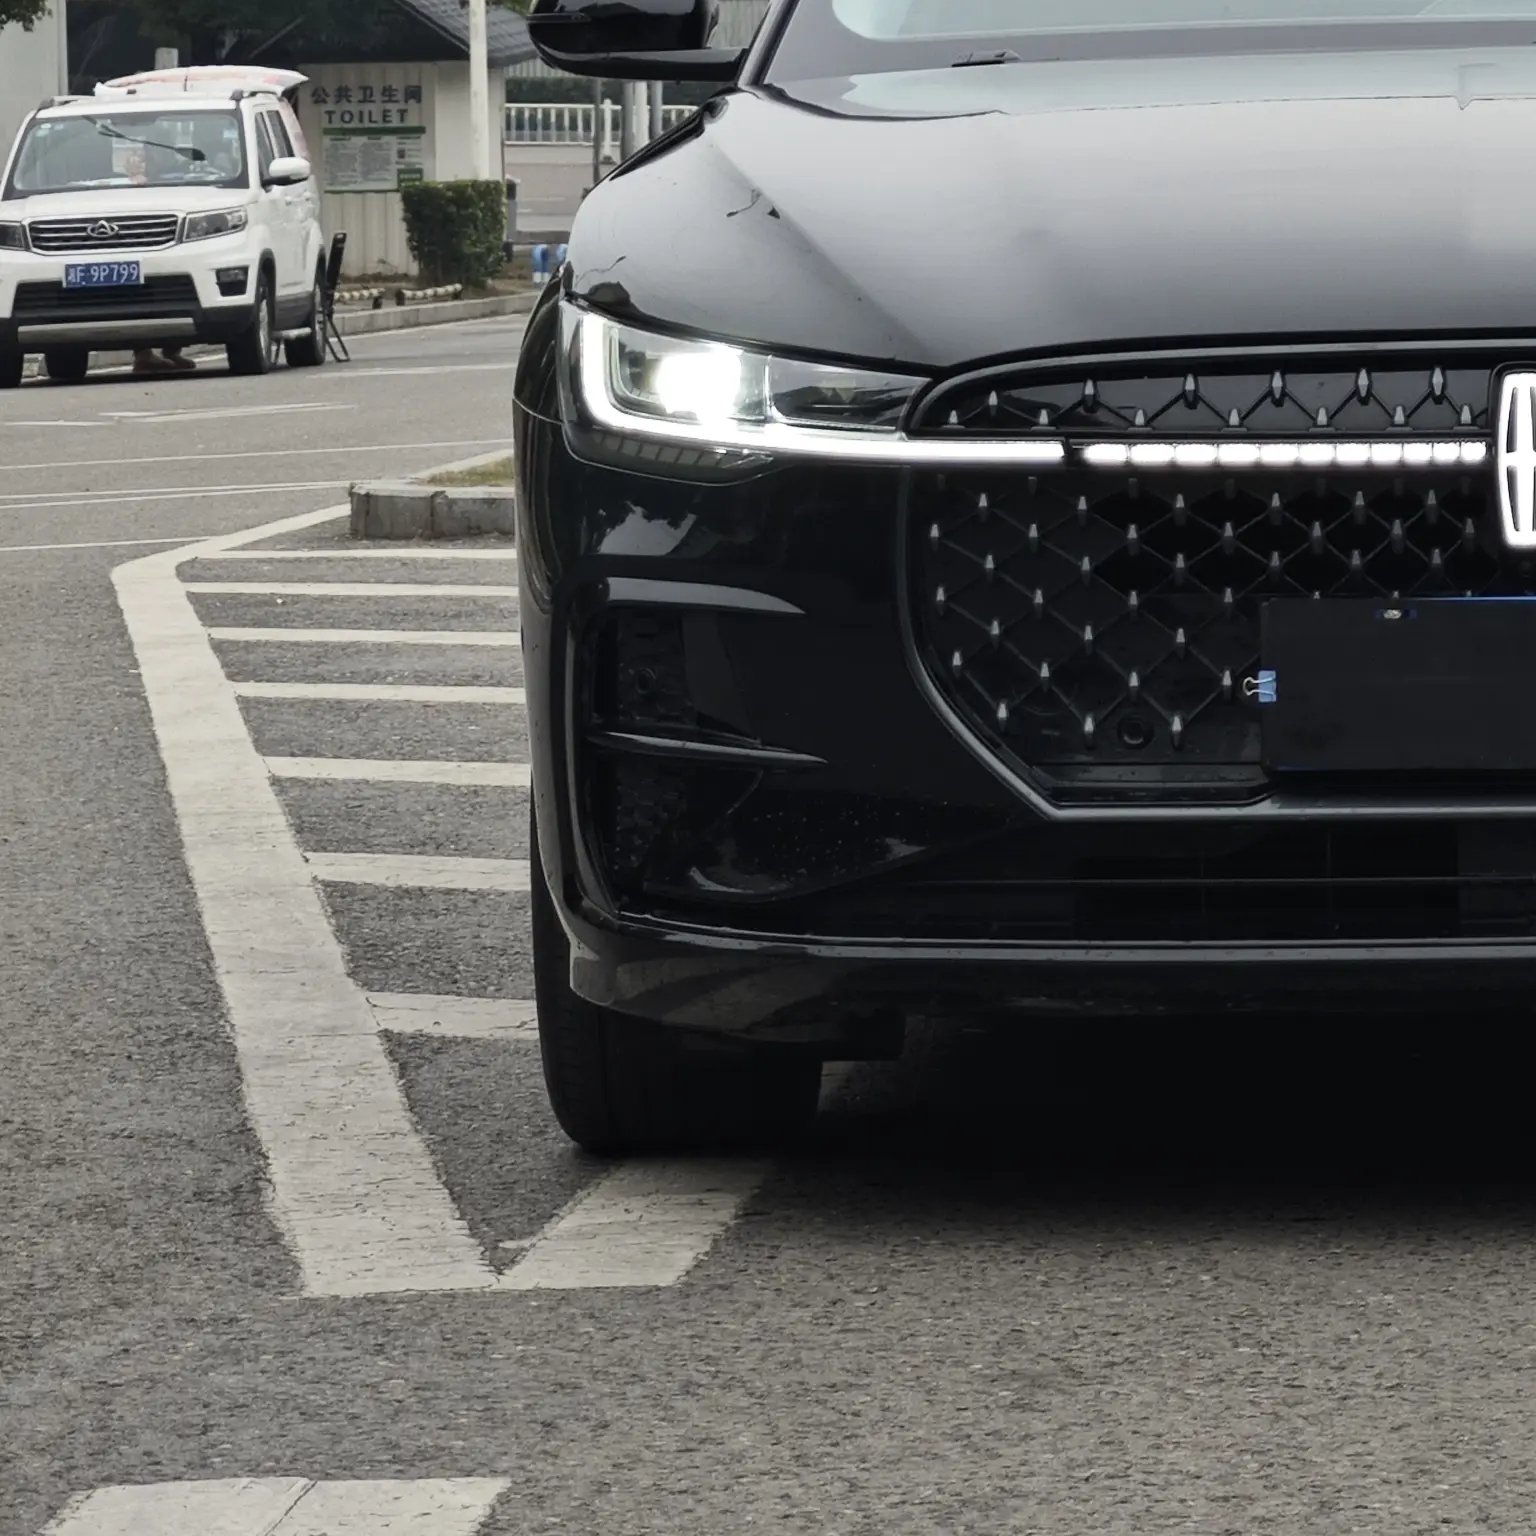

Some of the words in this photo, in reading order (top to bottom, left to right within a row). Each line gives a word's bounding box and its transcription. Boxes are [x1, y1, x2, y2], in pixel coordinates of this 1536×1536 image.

[311, 84, 422, 104] 公共卫生间
[324, 109, 408, 124] TOILET
